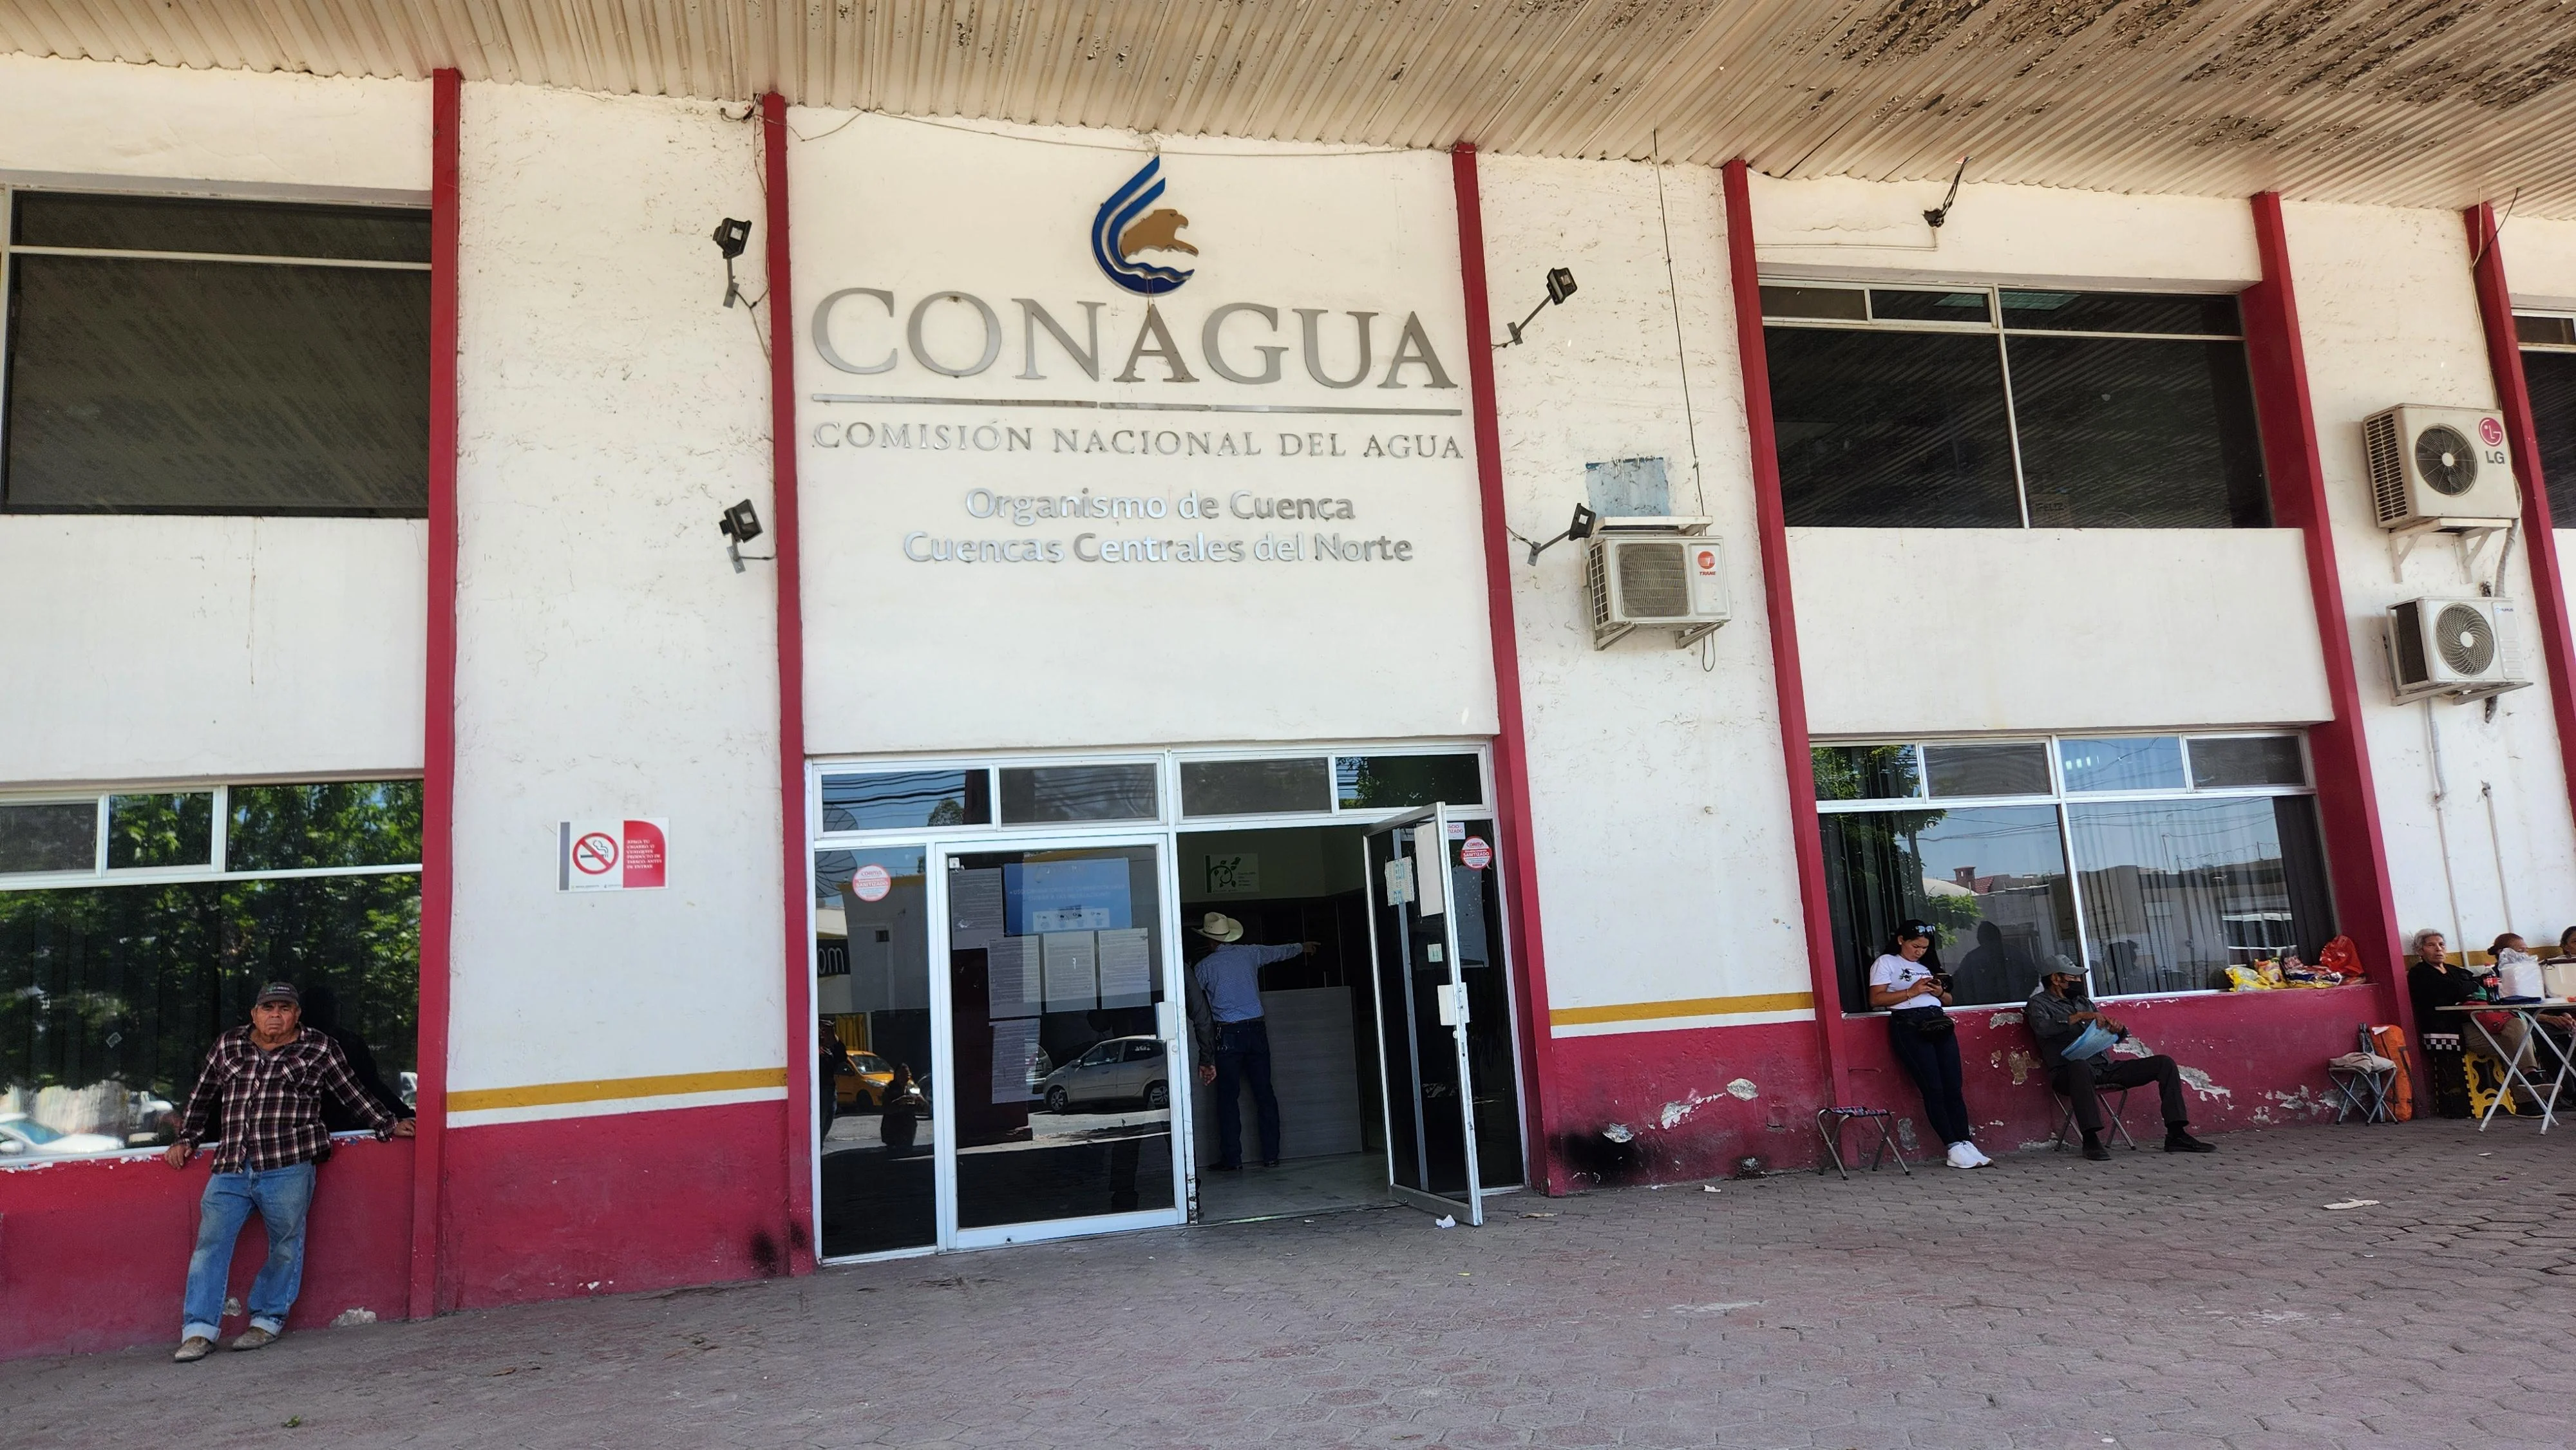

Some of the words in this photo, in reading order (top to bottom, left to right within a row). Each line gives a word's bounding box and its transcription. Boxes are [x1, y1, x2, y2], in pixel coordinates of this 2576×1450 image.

[812, 288, 1458, 389] CONAGUA
[813, 419, 1033, 451] COMISIÓN
[1053, 428, 1261, 456] NACIONAL
[1279, 433, 1346, 457] DEL
[1363, 434, 1464, 458] AGUA
[2485, 451, 2505, 464] LG
[966, 487, 1167, 527] Organismo
[1178, 490, 1220, 519] de
[1230, 490, 1356, 521] Cuenca
[904, 531, 1065, 563] Cuencas
[1074, 531, 1246, 563] Centrales
[1255, 531, 1305, 561] del
[1315, 532, 1413, 562] Norte
